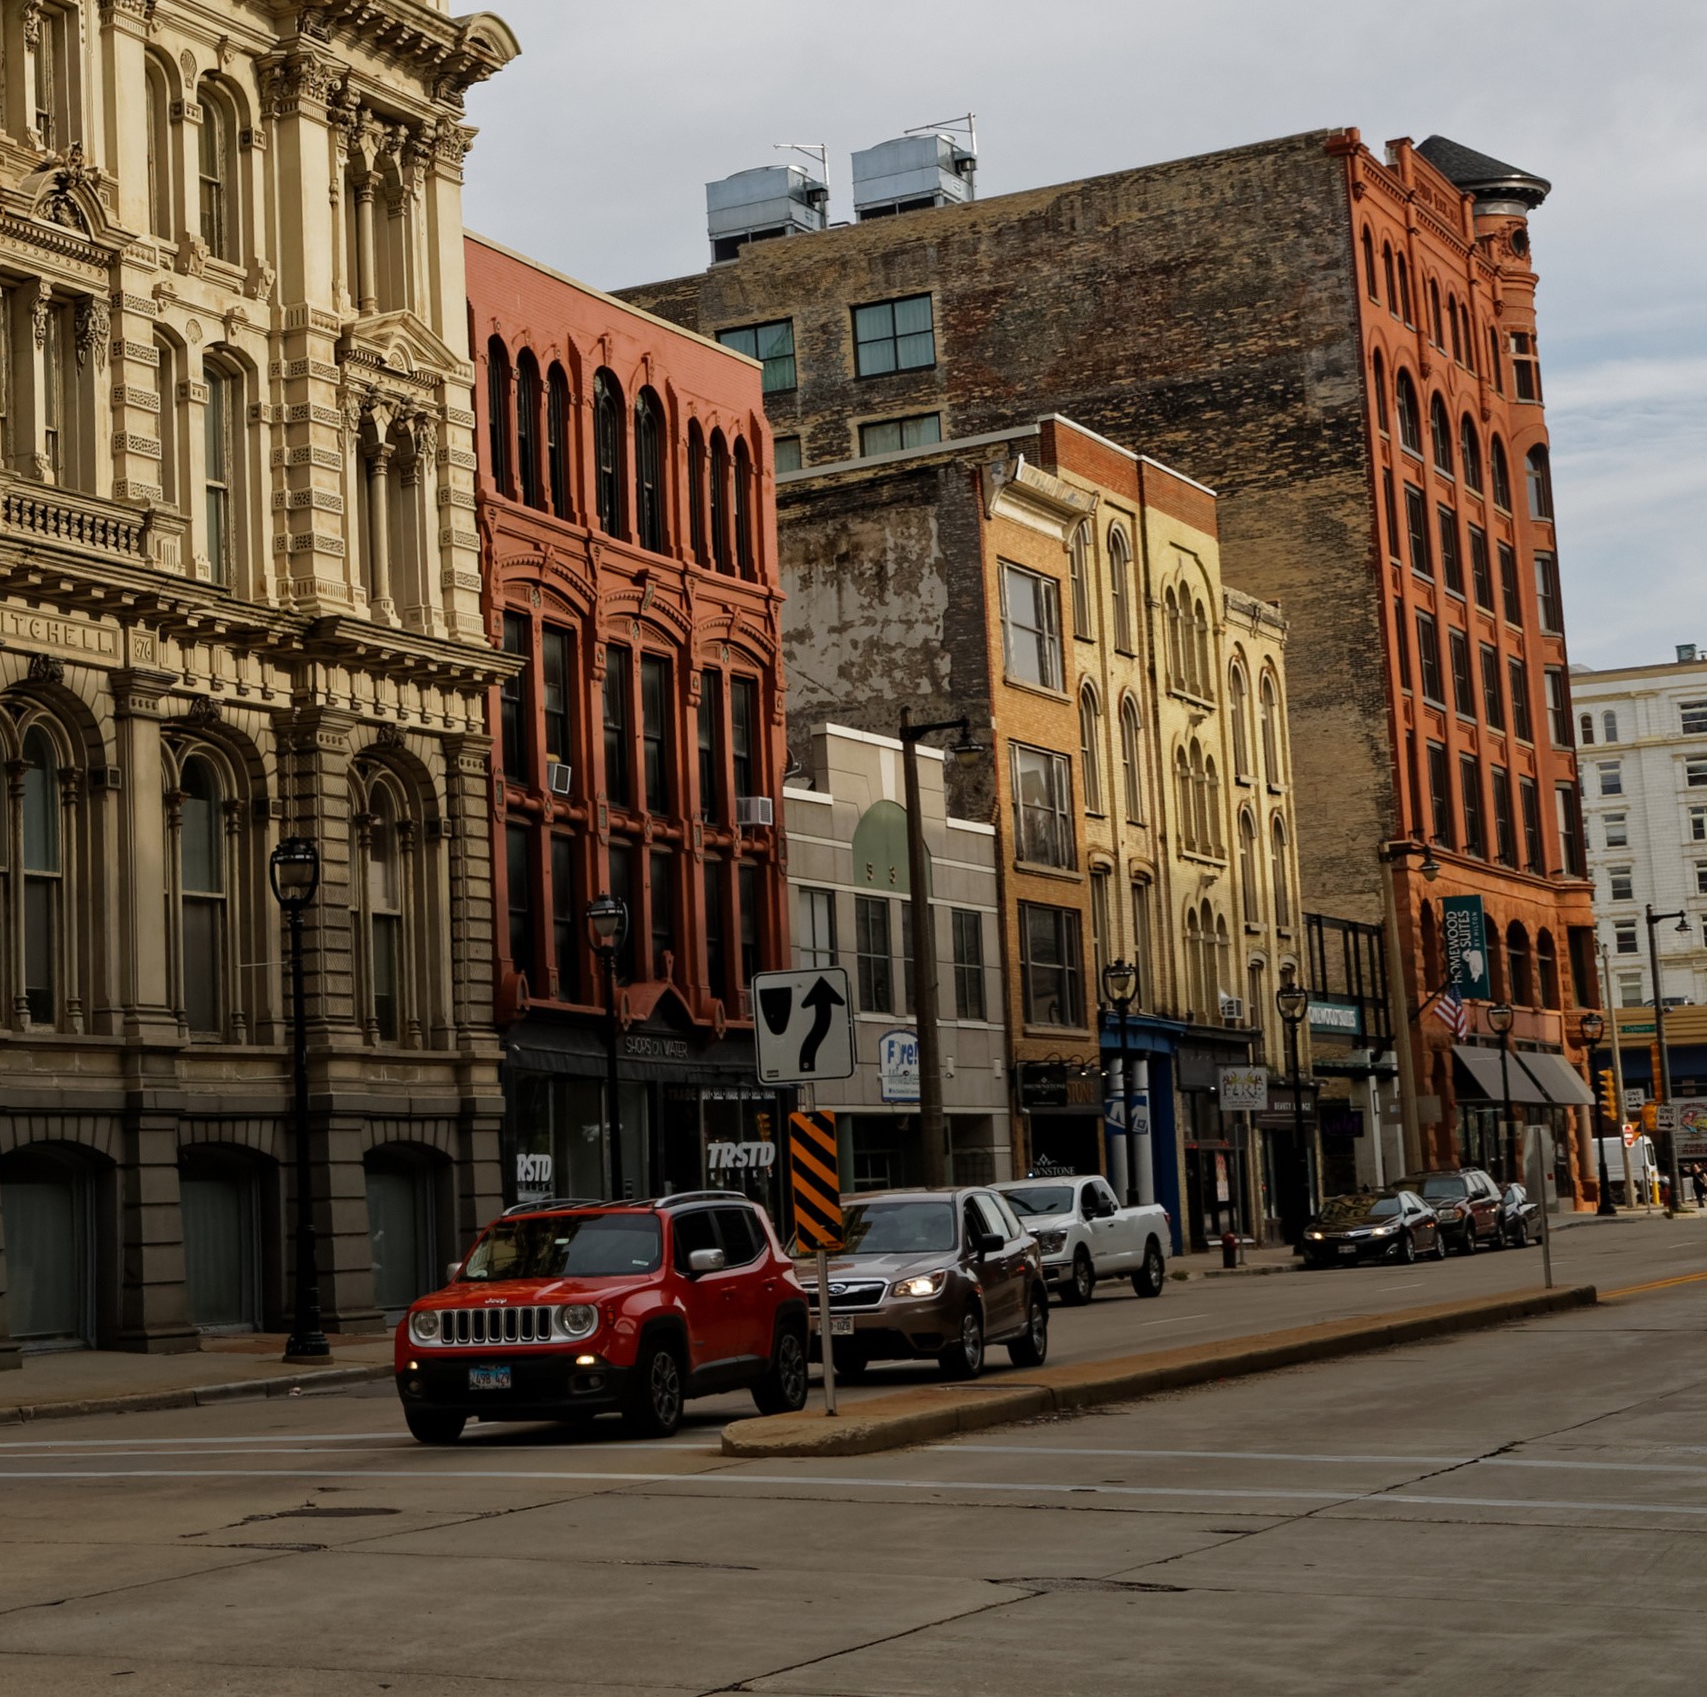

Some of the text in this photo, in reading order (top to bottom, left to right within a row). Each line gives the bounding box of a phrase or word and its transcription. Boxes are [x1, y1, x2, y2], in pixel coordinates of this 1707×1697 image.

[1457, 910, 1472, 947] SUITES
[1446, 911, 1463, 984] HOMEWOOD
[626, 1036, 652, 1054] SHOPS
[664, 1040, 689, 1058] WATER
[707, 1141, 776, 1169] TRSTD
